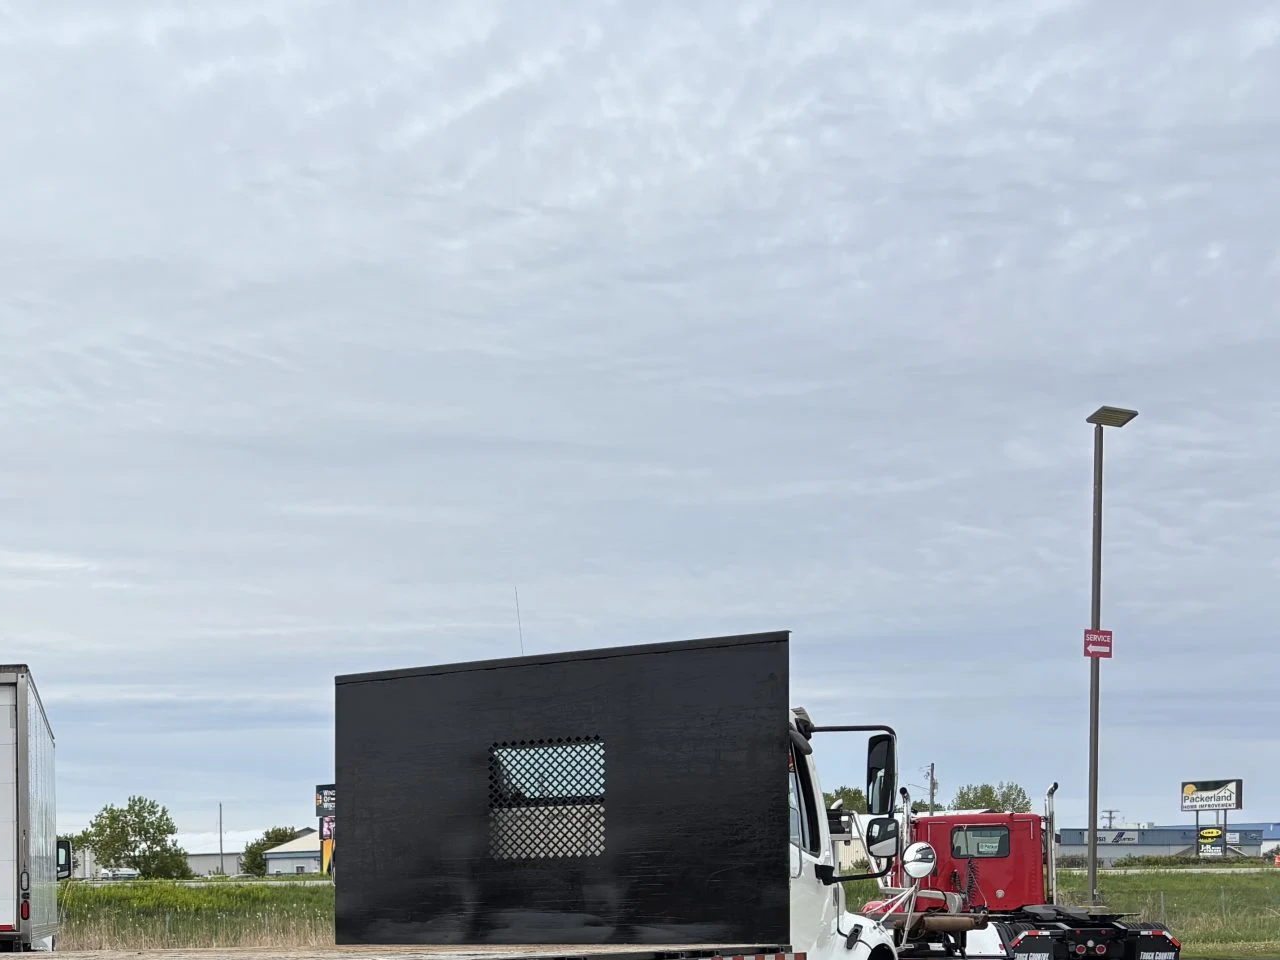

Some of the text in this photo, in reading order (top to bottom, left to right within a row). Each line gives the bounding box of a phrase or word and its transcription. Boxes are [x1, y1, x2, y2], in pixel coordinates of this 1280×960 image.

[1085, 633, 1111, 643] SERVICE
[1183, 793, 1232, 803] Packerland
[1028, 952, 1050, 960] COUNTRY
[1140, 951, 1176, 960] TRUCK COUNTRY
